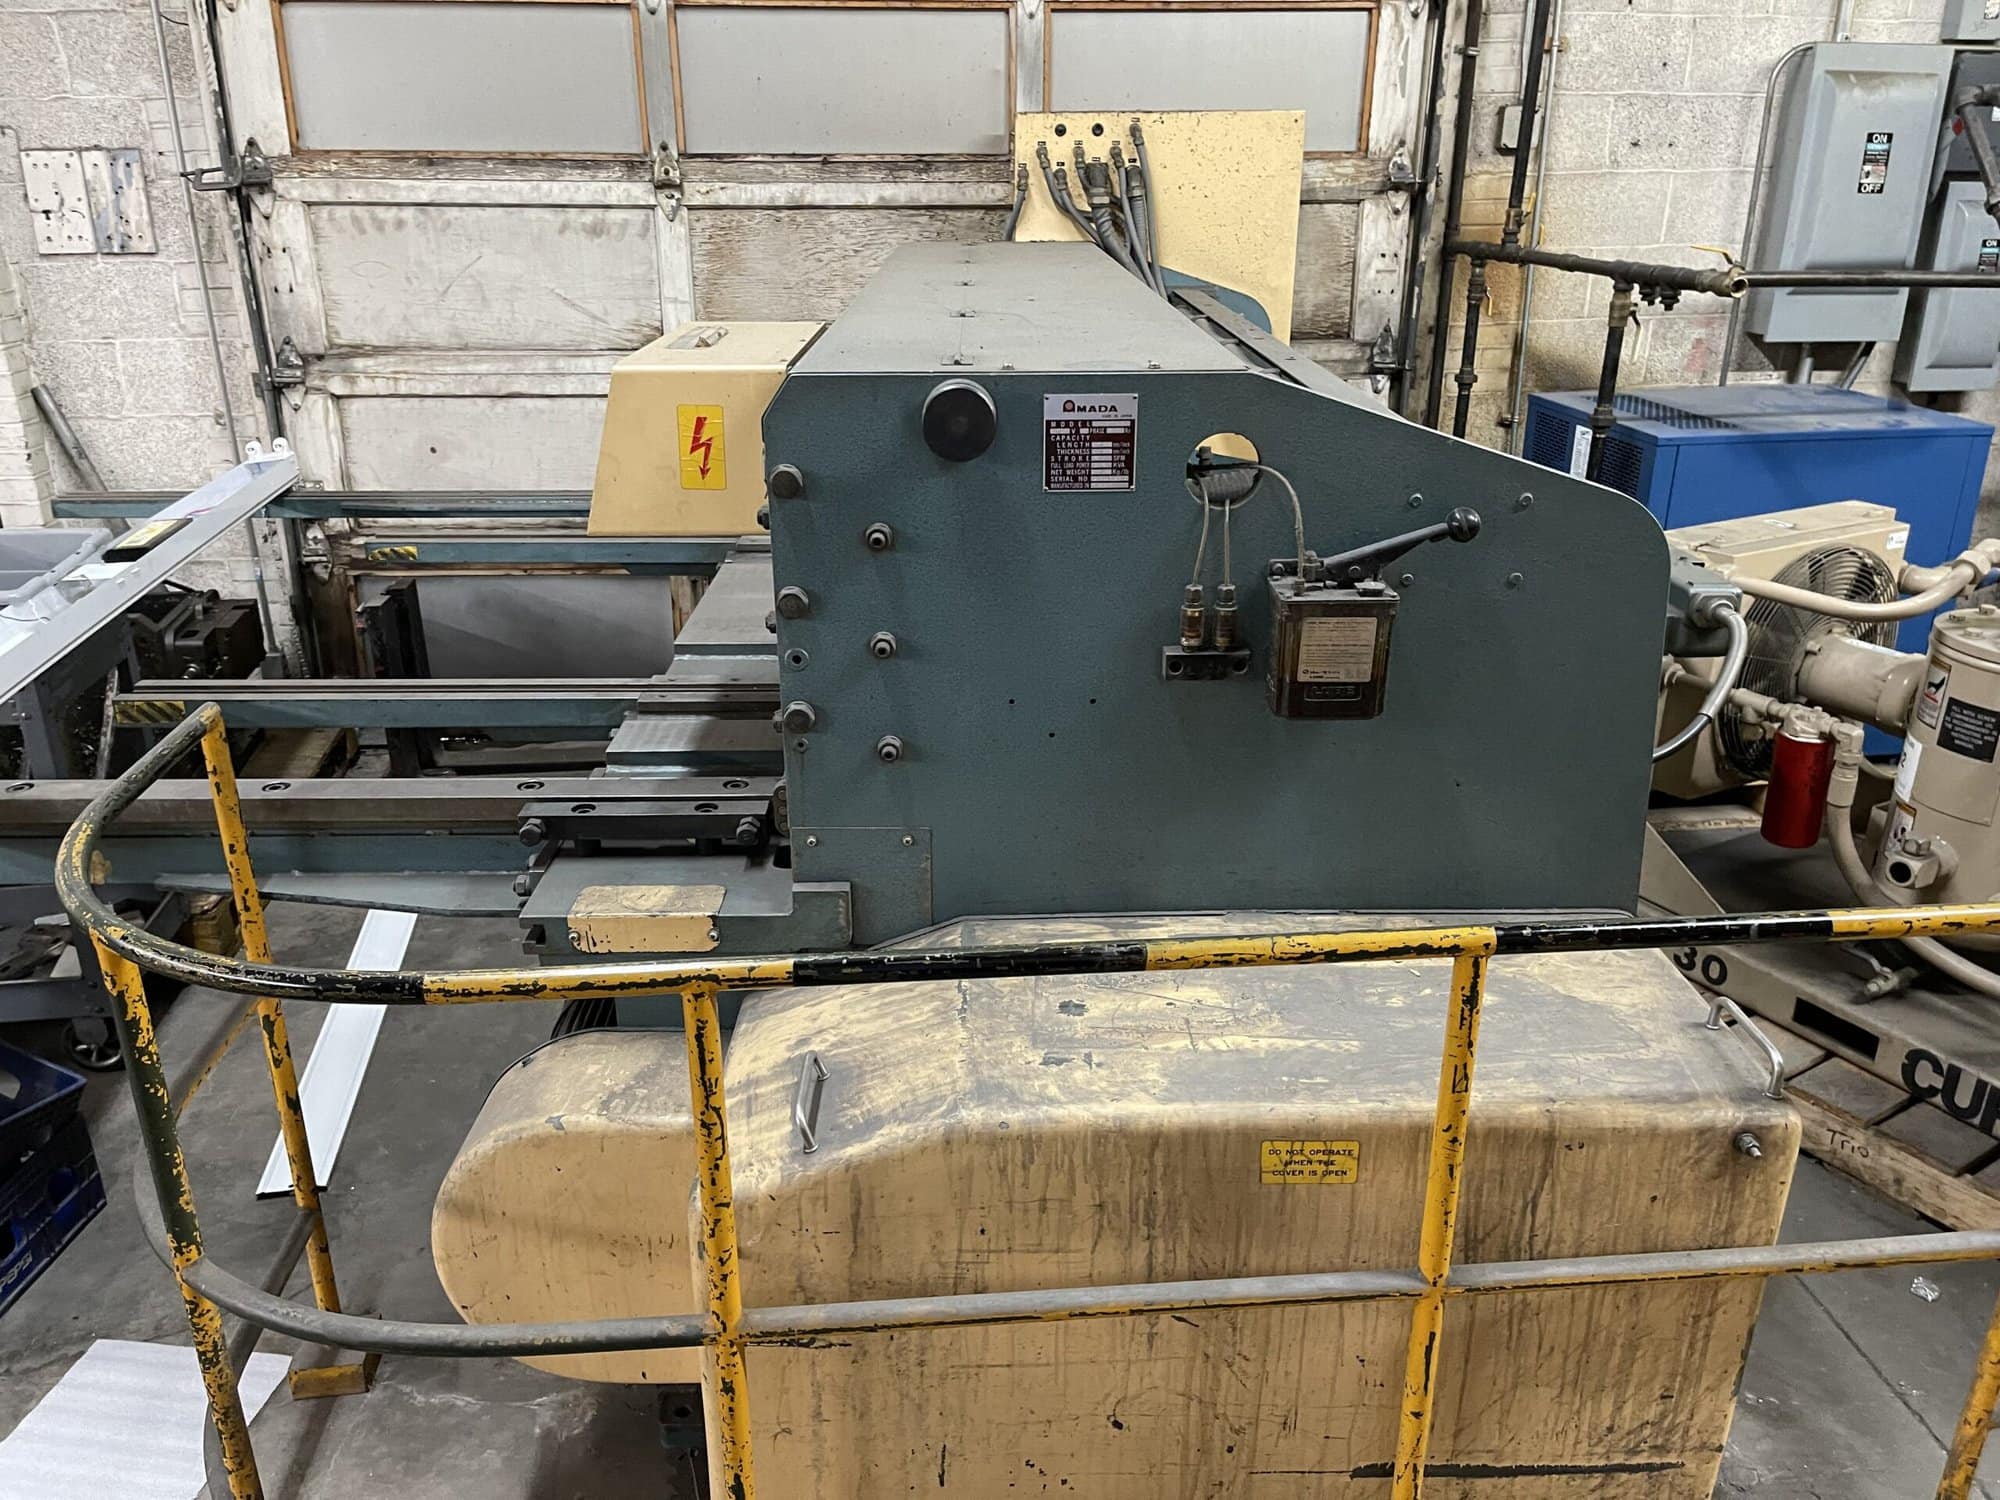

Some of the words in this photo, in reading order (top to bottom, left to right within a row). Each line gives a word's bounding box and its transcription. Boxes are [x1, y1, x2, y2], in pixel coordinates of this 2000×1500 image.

[1872, 133, 1888, 143] ON
[1861, 183, 1882, 193] OFF
[1985, 239, 1998, 247] ON
[1673, 946, 1728, 986] 30
